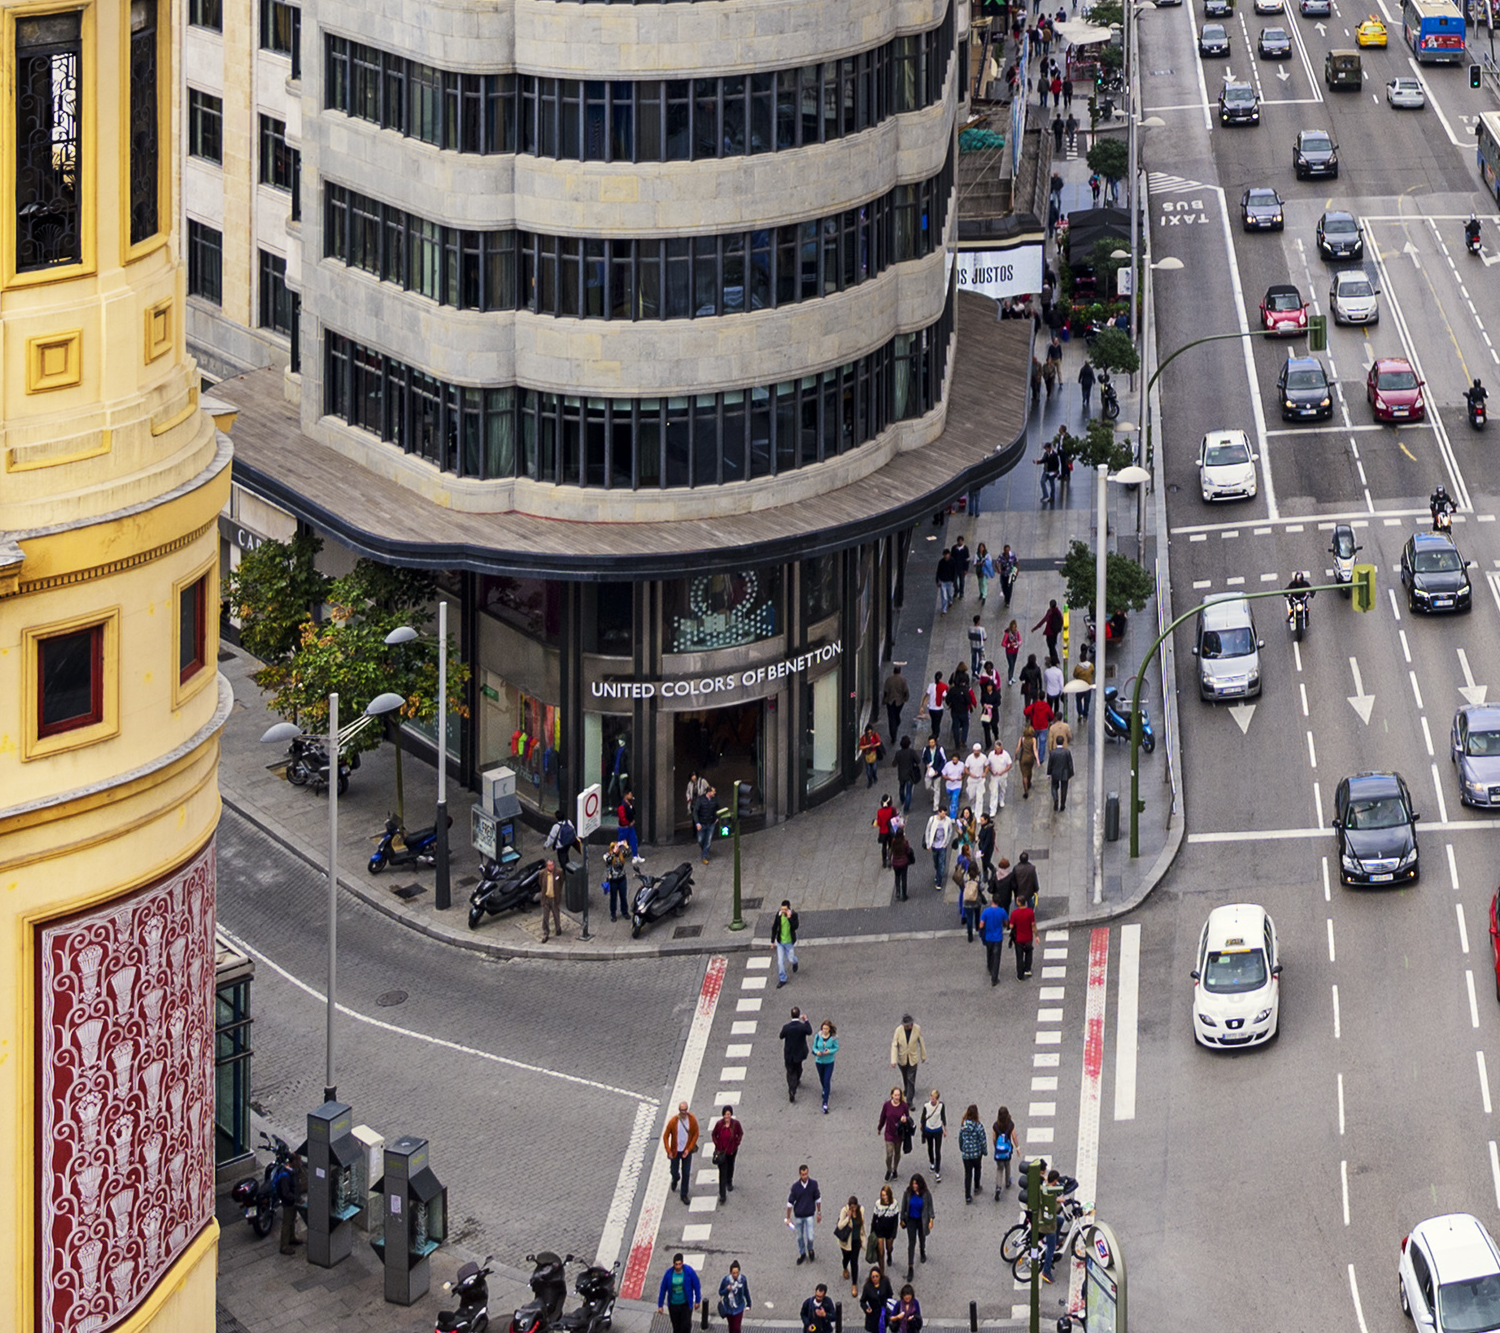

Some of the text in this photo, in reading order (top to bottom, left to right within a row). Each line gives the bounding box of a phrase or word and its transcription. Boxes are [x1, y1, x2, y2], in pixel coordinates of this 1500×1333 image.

[1162, 200, 1204, 212] BUS
[1161, 213, 1210, 226] TAXI
[971, 264, 1014, 284] JUSTOS
[591, 681, 655, 698] UNITED
[660, 675, 736, 697] COLORS
[741, 669, 766, 687] OF
